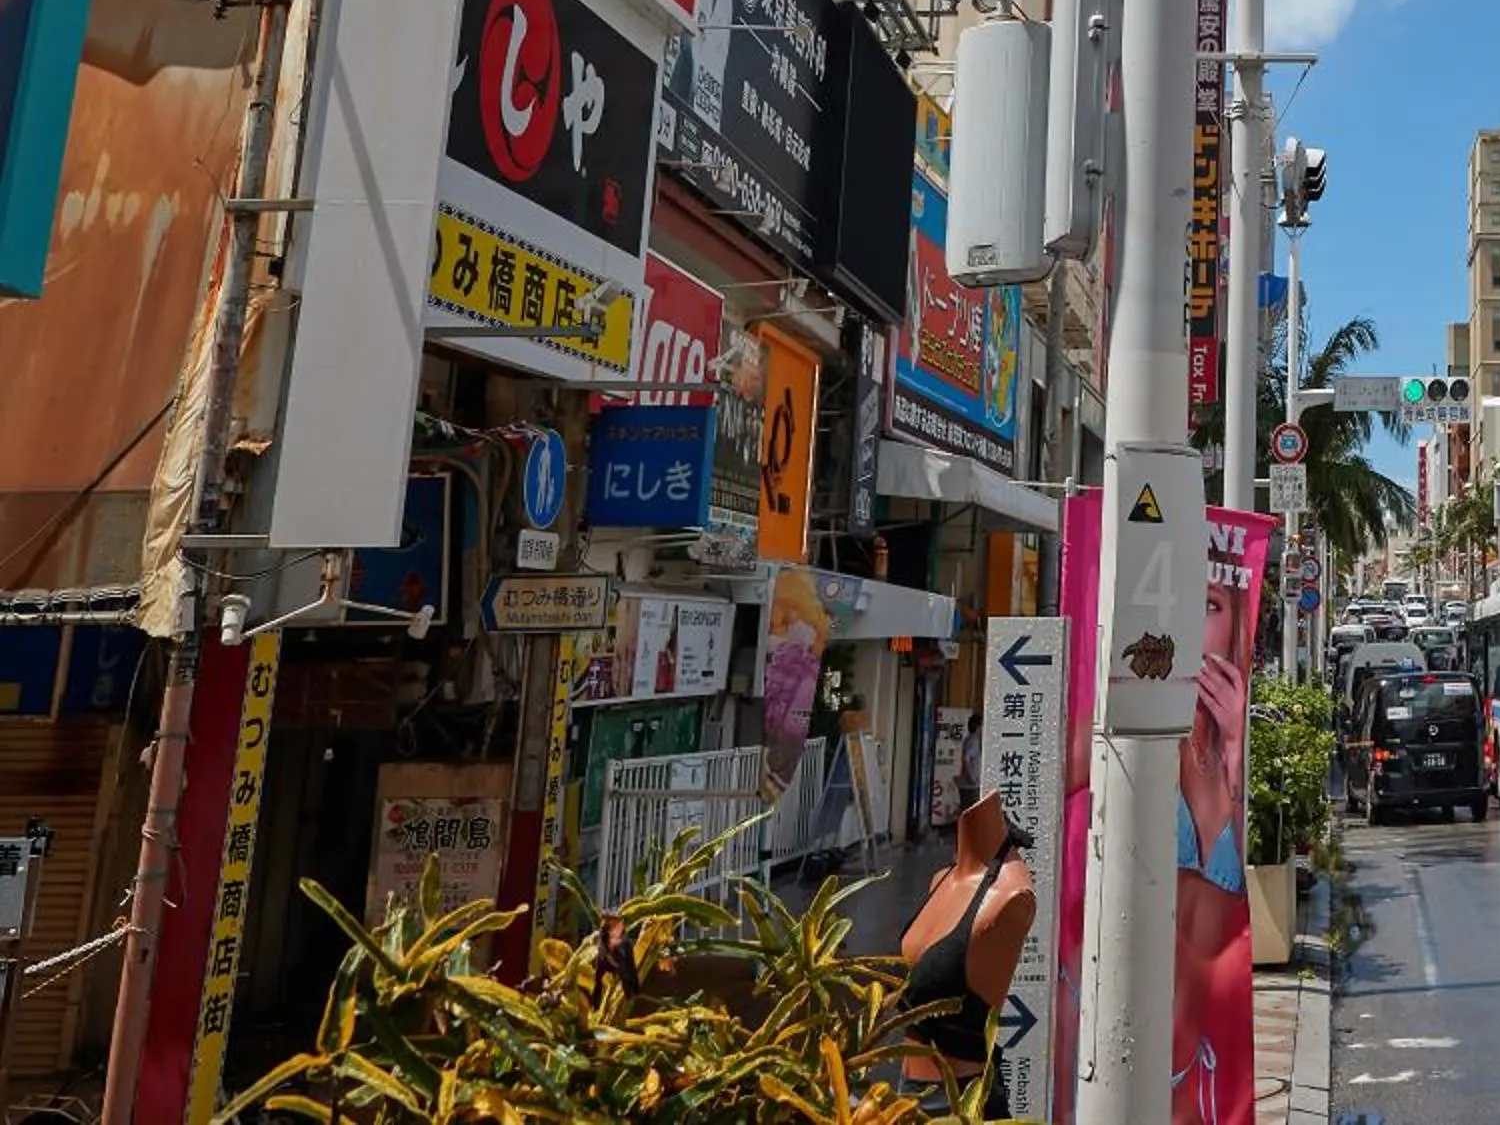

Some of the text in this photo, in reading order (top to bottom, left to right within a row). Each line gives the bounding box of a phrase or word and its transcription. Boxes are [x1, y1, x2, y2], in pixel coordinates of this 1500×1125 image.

[455, 3, 605, 171] しや
[1192, 346, 1208, 377] Tax
[604, 460, 693, 501] にしき
[504, 586, 601, 607] むつみ橋通り
[1130, 540, 1177, 630] 4
[1028, 691, 1044, 747] Daiichi
[1001, 692, 1028, 823] 第一牧志
[1027, 750, 1042, 810] Makishi
[203, 661, 273, 1035] むつみ橋商店街
[404, 817, 491, 850] 鳩間島
[1015, 1057, 1031, 1115] Miebashi
